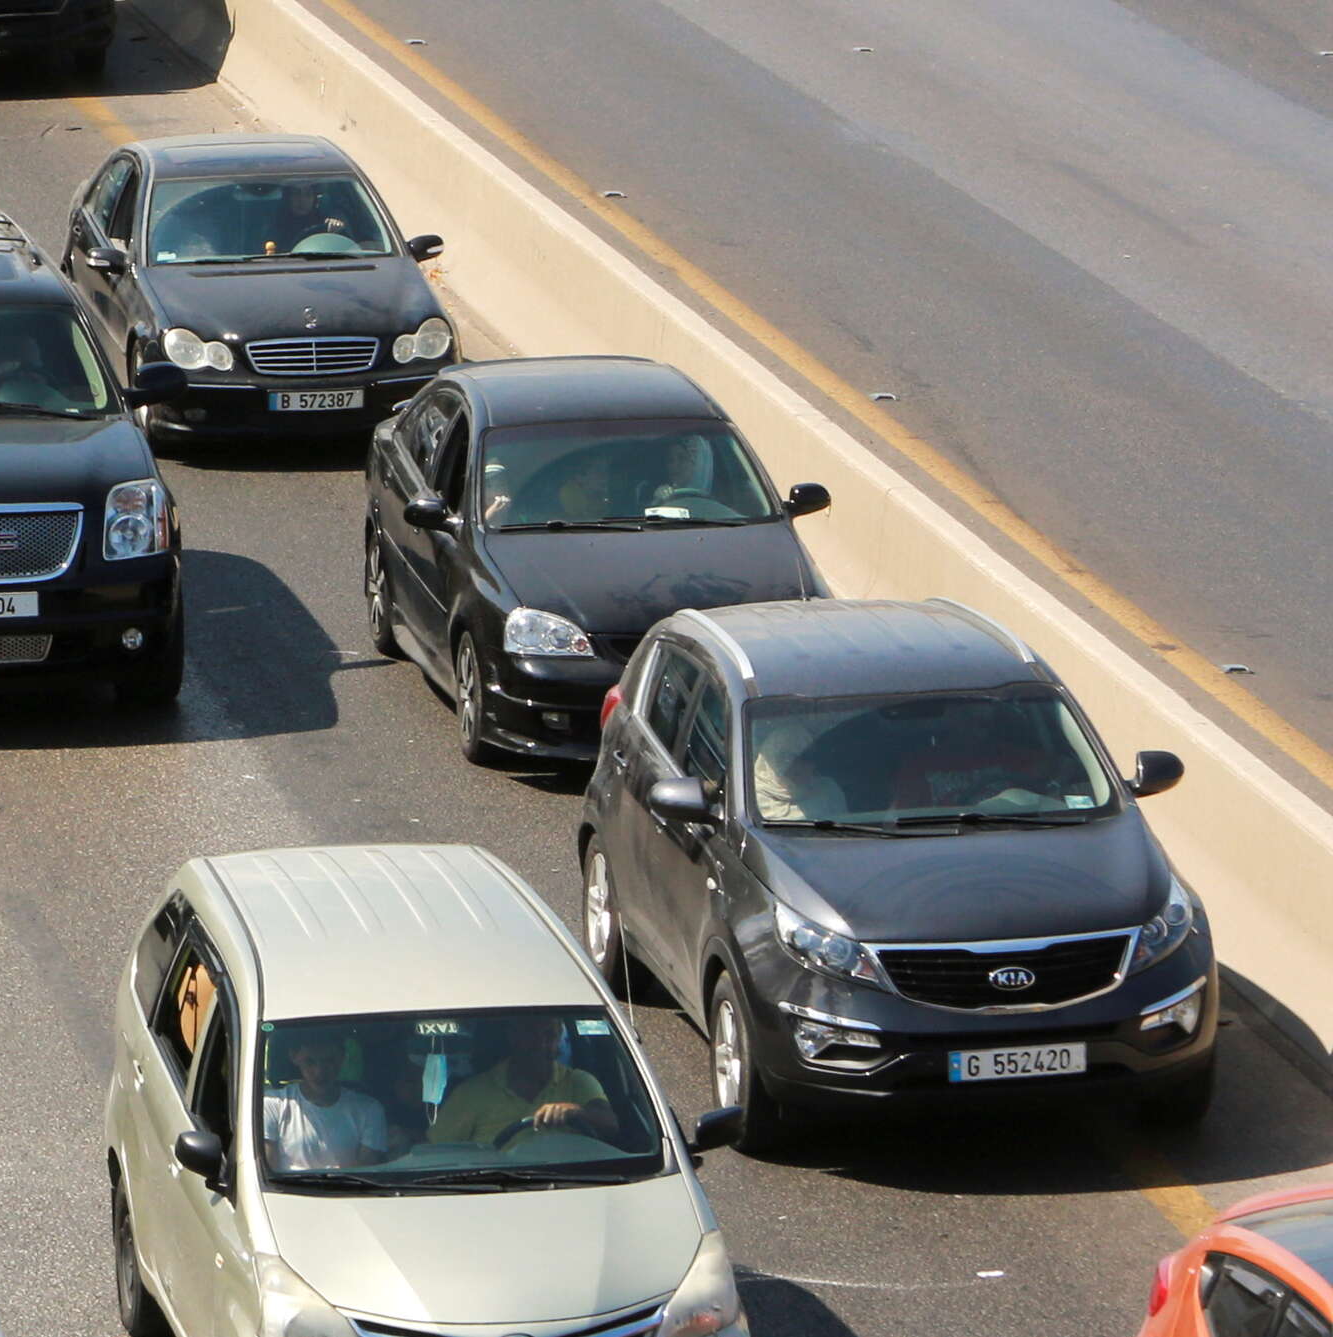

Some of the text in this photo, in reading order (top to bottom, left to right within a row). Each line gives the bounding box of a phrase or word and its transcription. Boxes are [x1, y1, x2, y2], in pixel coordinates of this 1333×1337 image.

[281, 392, 354, 408] B 572387
[997, 971, 1029, 985] KIA
[967, 1048, 1071, 1076] G 552420
